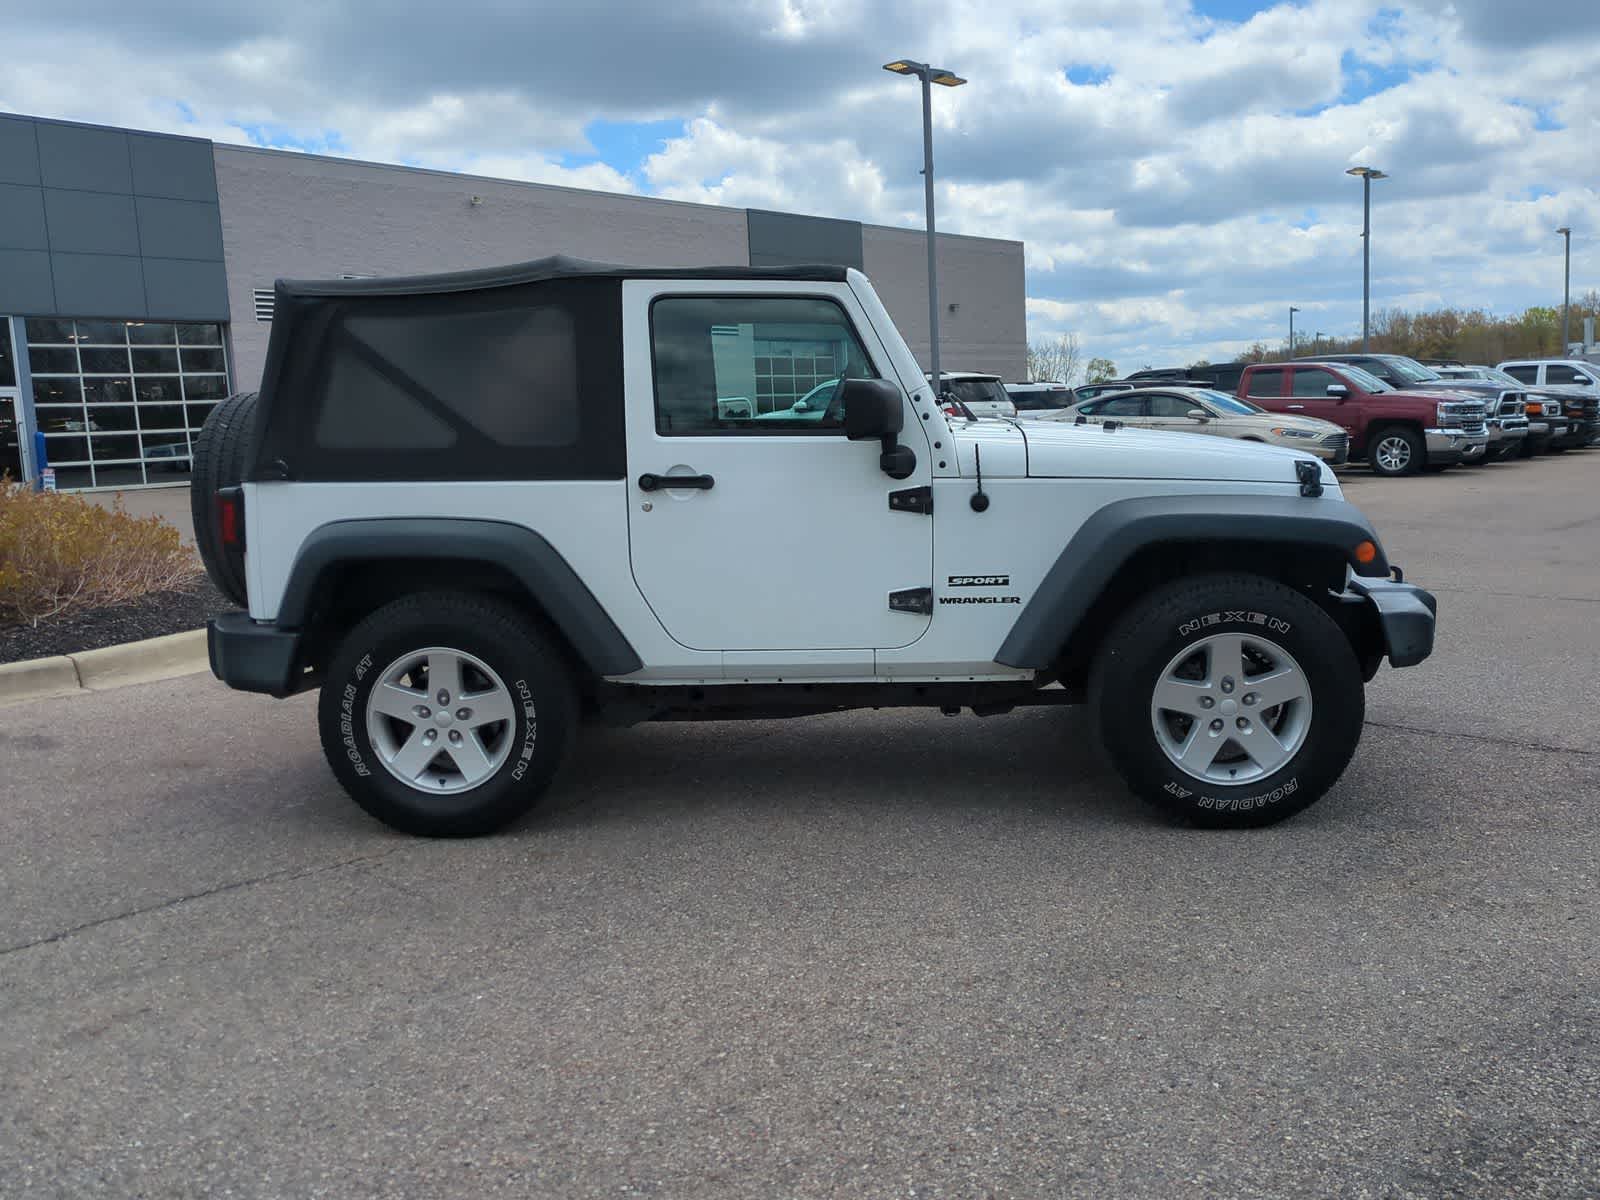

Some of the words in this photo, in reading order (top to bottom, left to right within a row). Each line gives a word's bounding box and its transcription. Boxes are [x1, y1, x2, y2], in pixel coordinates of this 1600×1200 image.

[948, 576, 1009, 586] SPORT
[939, 596, 1021, 605] WRANGLER
[1179, 610, 1291, 636] NEXEN
[355, 654, 373, 681] AT
[341, 683, 371, 777] ROADIAN
[511, 679, 537, 781] NEXEN
[1163, 781, 1193, 799] AT
[1198, 777, 1299, 811] ROADIAN
